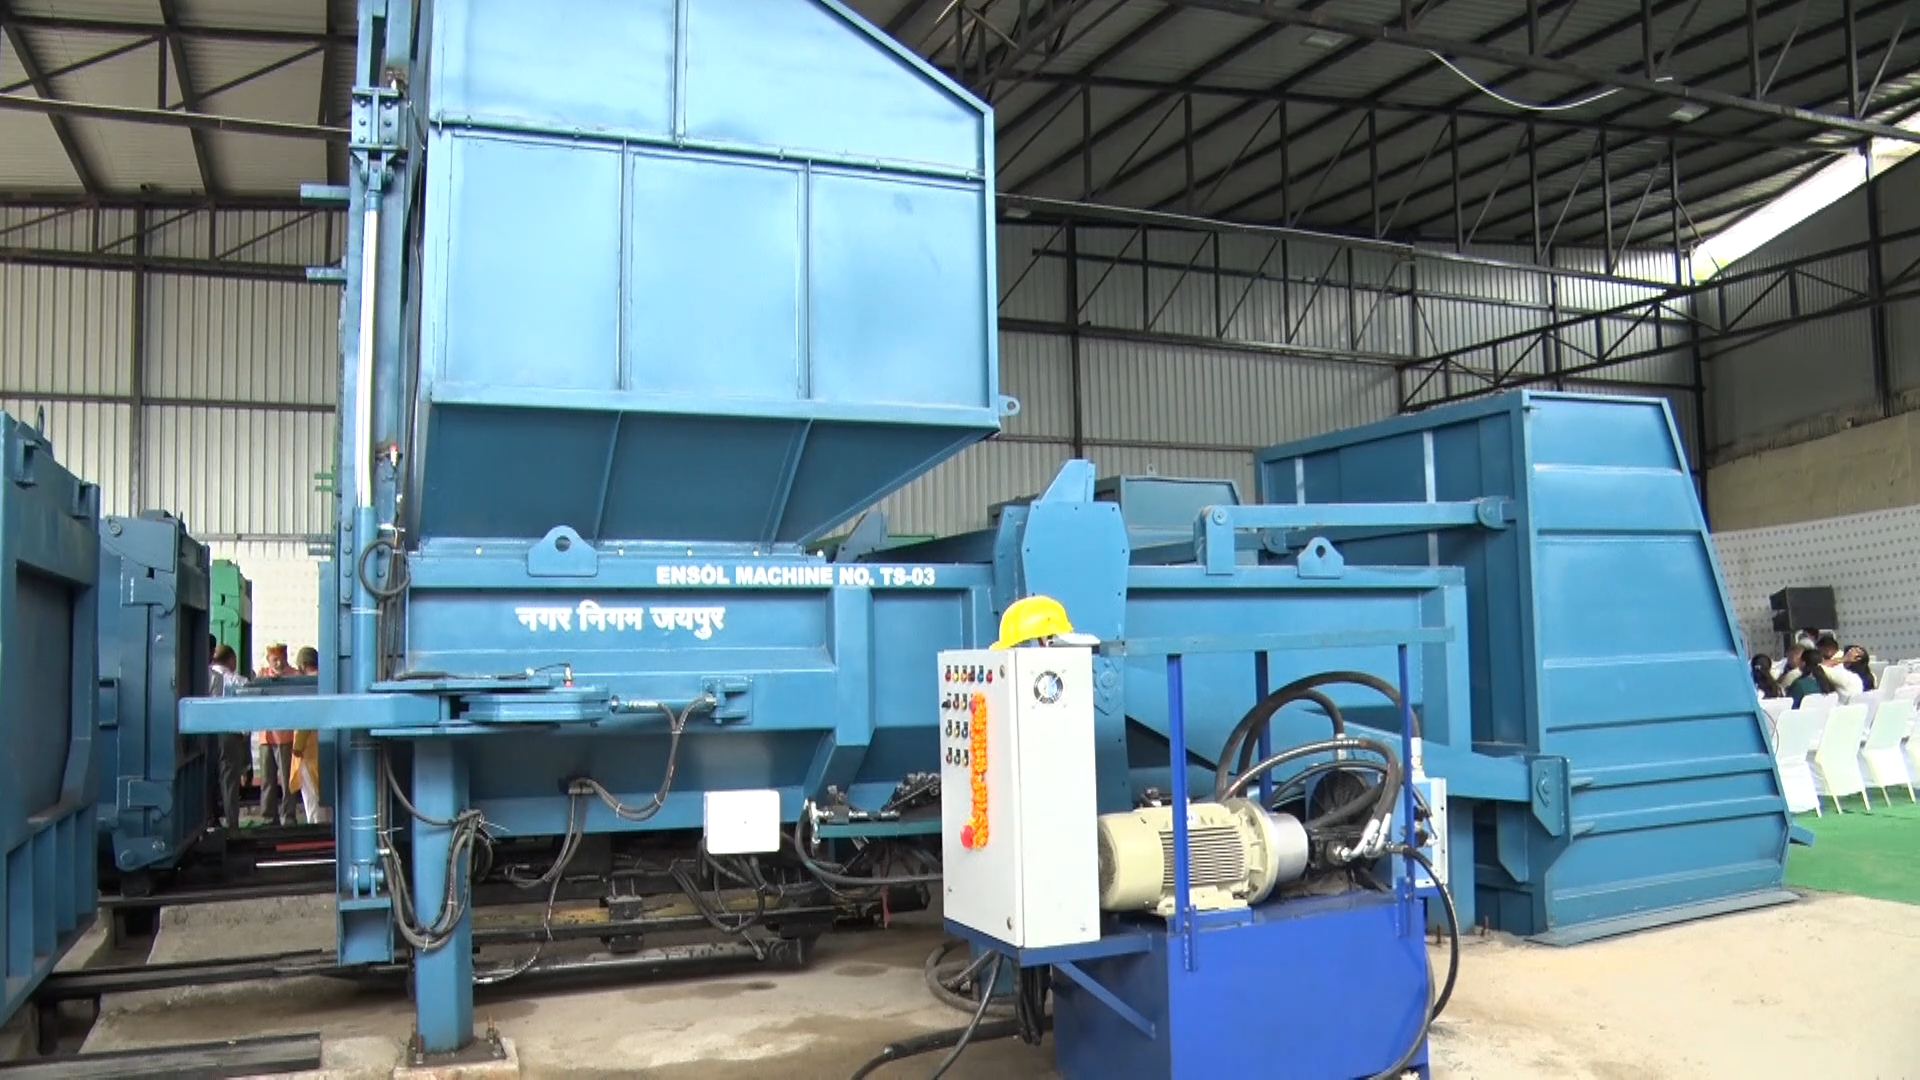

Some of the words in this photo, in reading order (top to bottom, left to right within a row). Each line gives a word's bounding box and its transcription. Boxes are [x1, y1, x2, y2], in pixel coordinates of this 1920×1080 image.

[736, 566, 833, 586] MACHINE
[839, 567, 875, 586] NO.
[879, 566, 936, 586] TS-03
[515, 606, 572, 631] नगर
[577, 600, 643, 631] निगम
[650, 606, 725, 639] जयपुर
